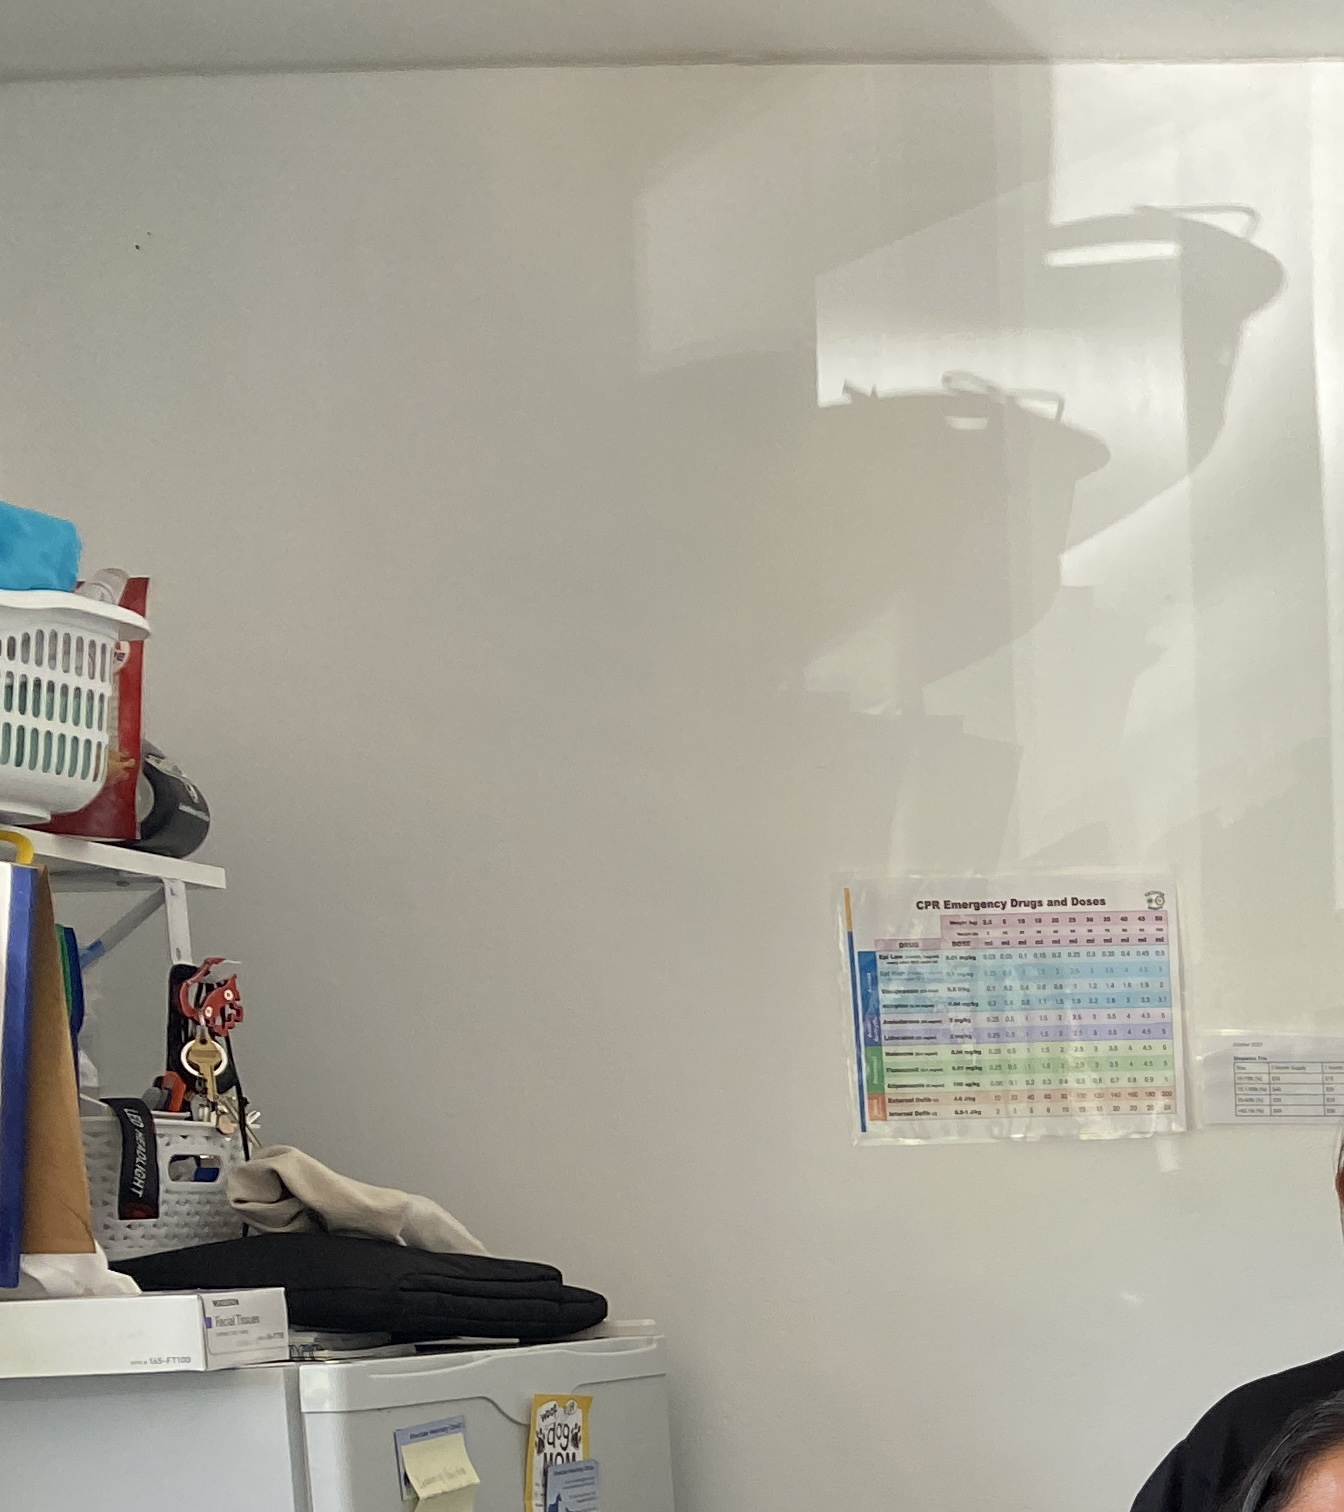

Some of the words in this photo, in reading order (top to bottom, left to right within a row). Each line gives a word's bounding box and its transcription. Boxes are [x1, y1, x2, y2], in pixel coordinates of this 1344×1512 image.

[916, 900, 940, 910] CPR
[944, 899, 1007, 911] Emergency
[1010, 898, 1044, 909] Drugs
[1046, 898, 1068, 907] and
[1071, 897, 1106, 906] Doses
[123, 1108, 145, 1129] LED
[131, 1129, 148, 1198] HEADLIGHT
[215, 1315, 235, 1327] Facial
[547, 1422, 570, 1451] dog
